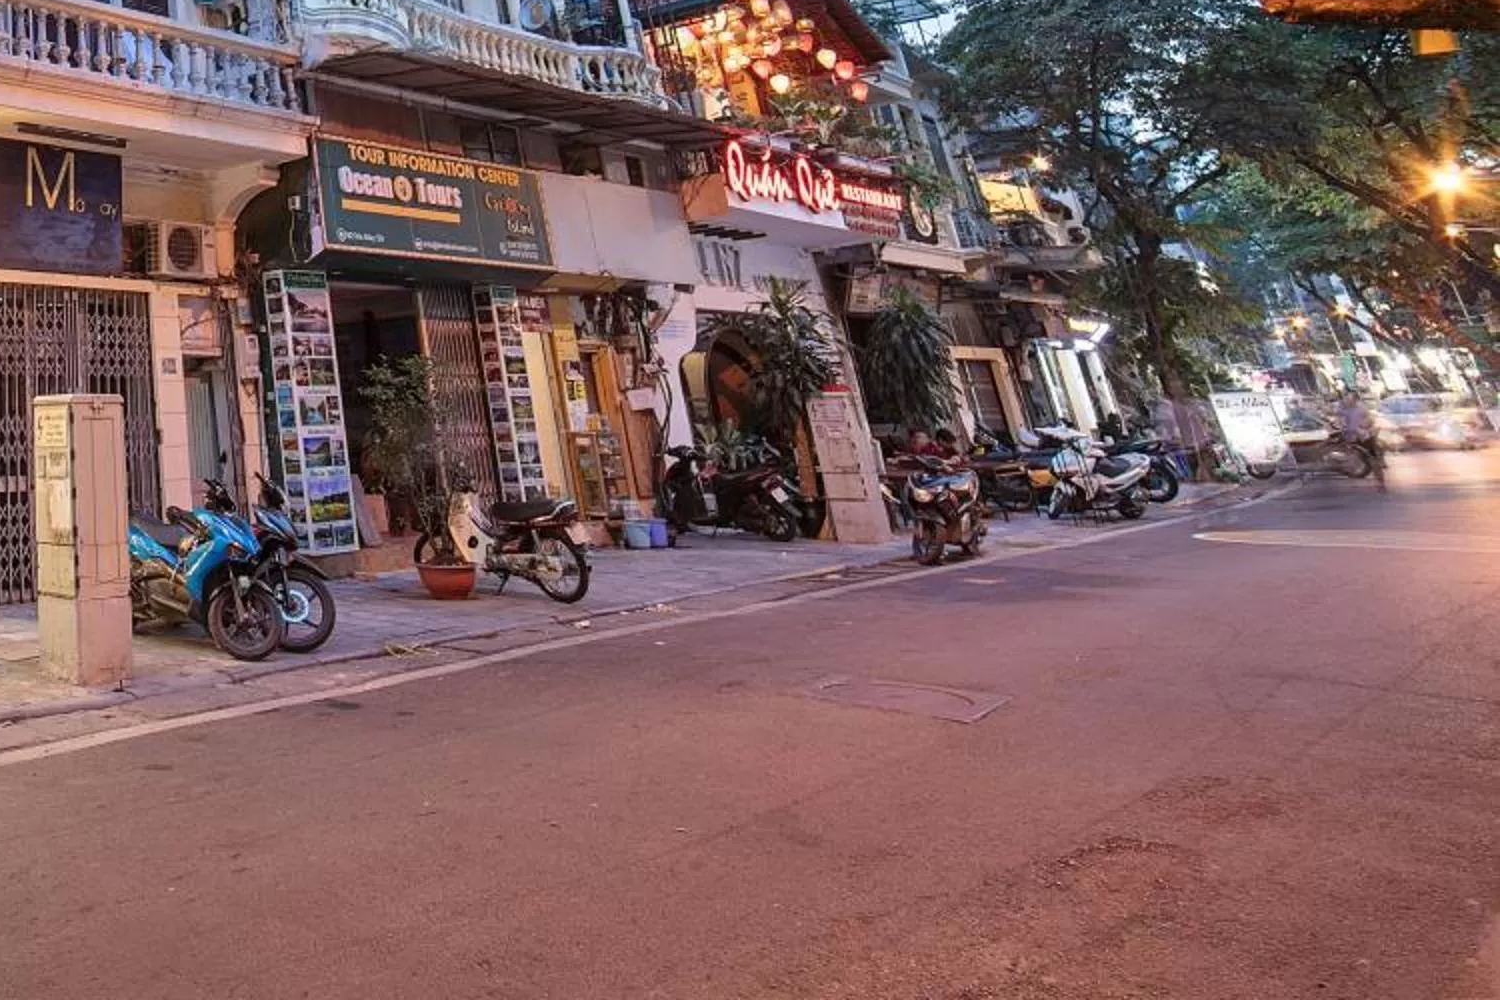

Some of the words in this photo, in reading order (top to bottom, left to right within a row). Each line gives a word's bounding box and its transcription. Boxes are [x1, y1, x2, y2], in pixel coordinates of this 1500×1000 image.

[337, 165, 394, 199] Ocean
[413, 176, 463, 209] Tours
[347, 144, 387, 168] TOUR
[388, 151, 476, 180] INFORMATION
[477, 166, 520, 188] CENTER
[840, 181, 903, 212] RESTAURANT
